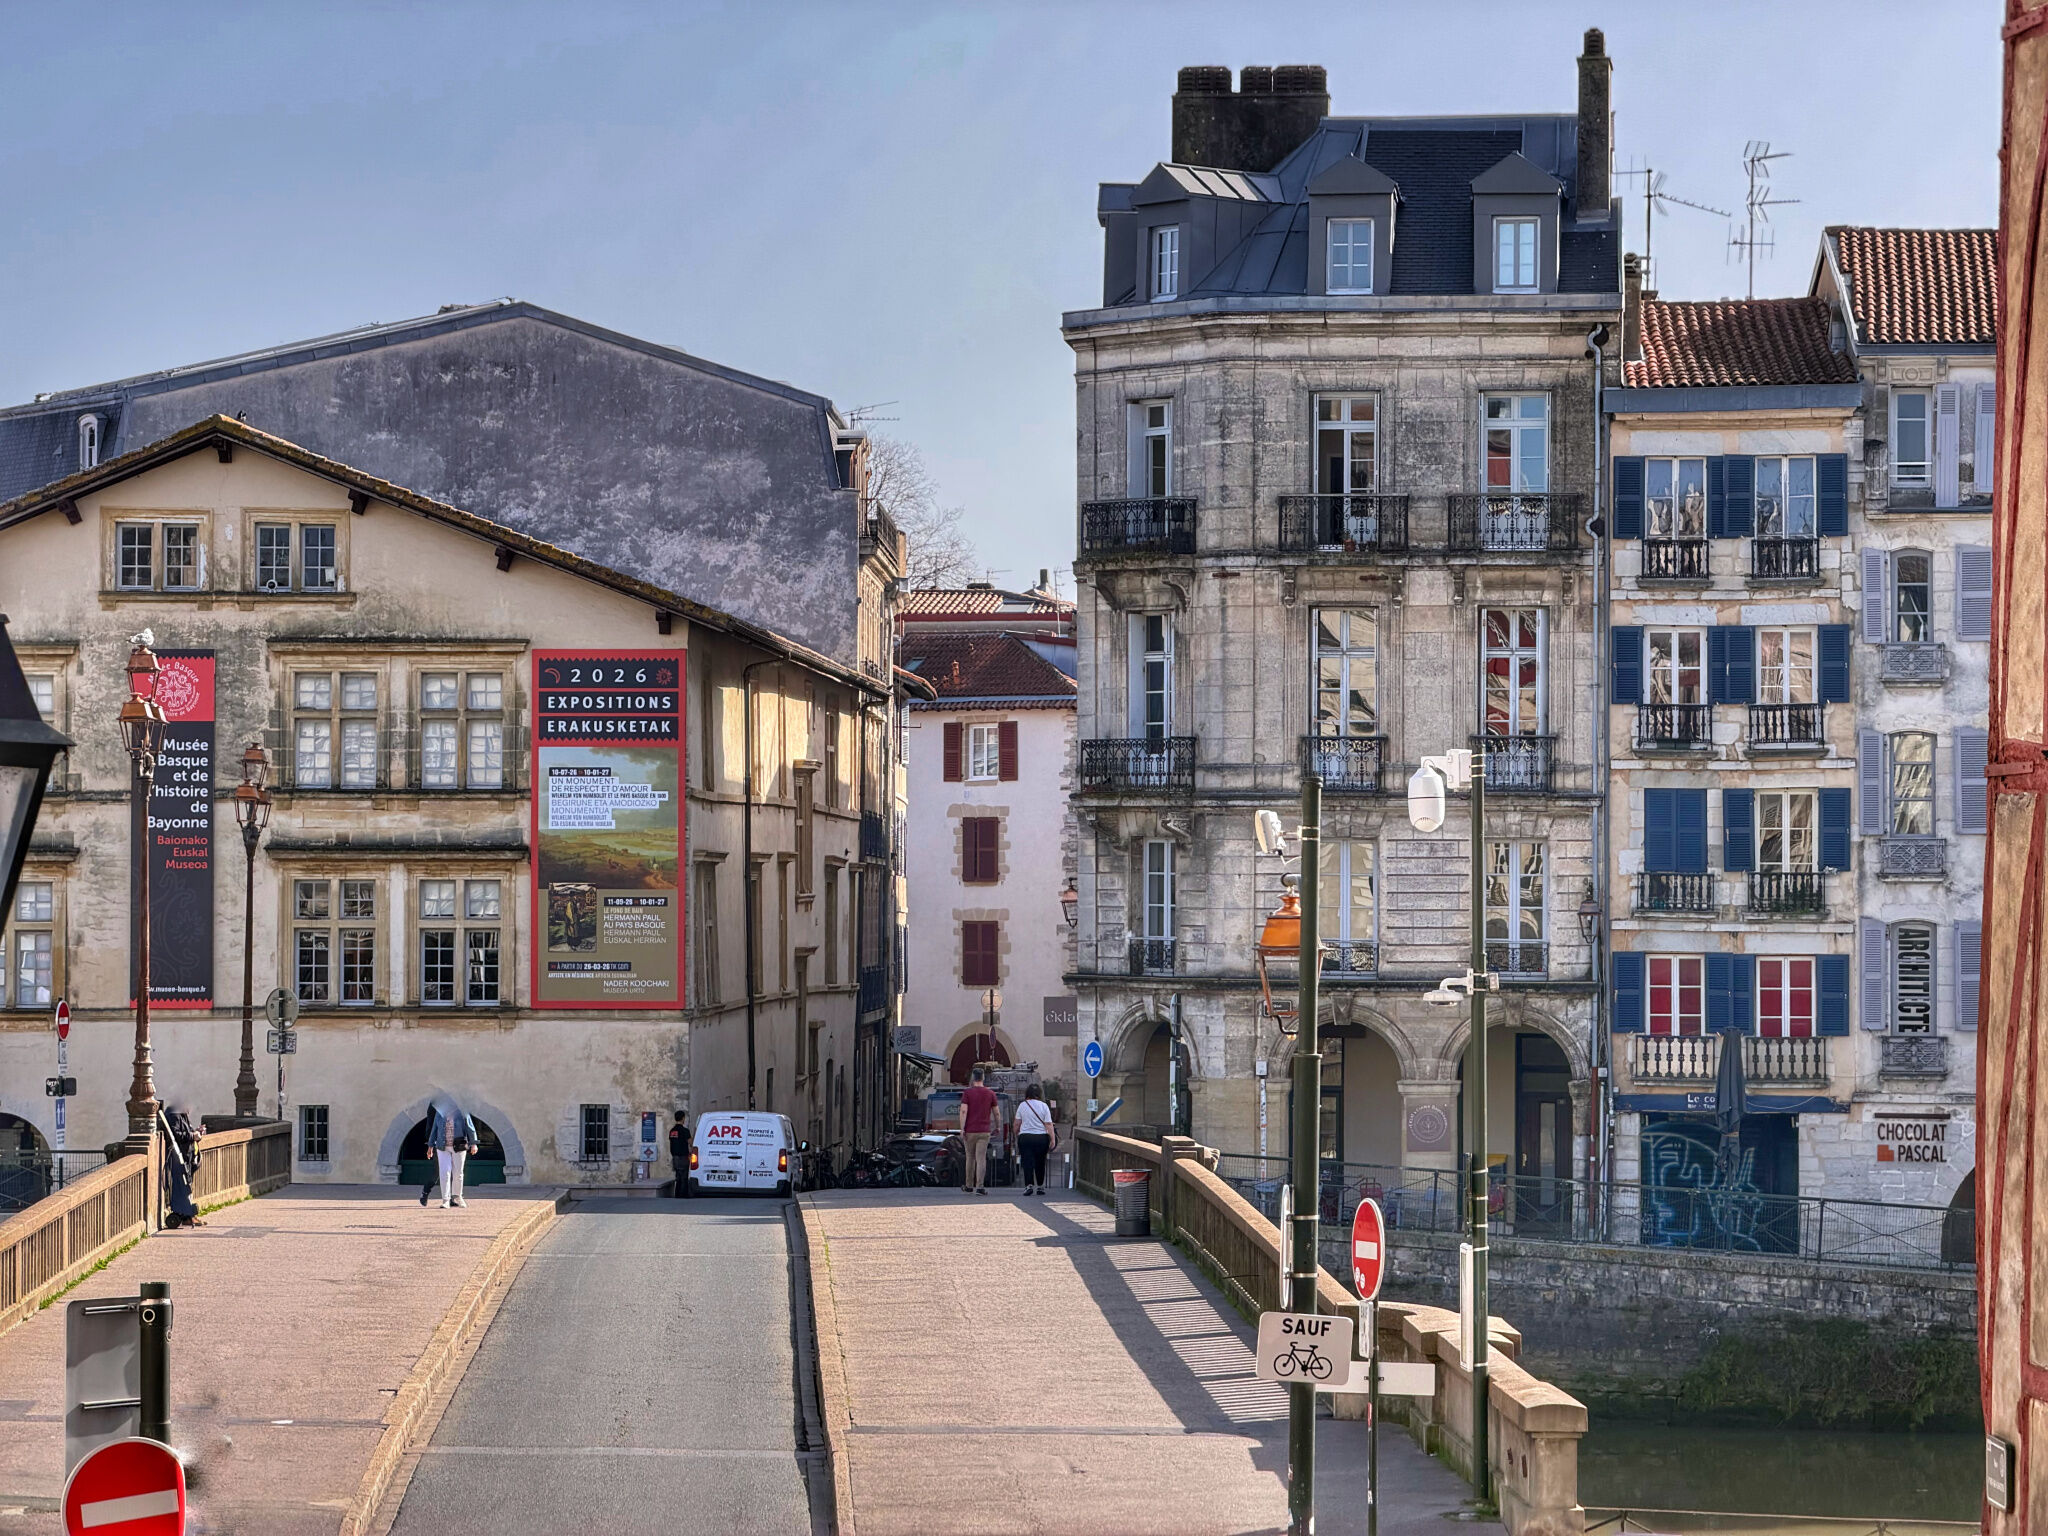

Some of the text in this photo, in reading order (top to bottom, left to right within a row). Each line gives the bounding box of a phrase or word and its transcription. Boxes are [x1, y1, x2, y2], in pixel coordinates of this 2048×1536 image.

[175, 662, 199, 682] Basque
[571, 669, 646, 683] 2026
[548, 696, 672, 709] EXPOSITIONS
[547, 721, 671, 733] ERAKUSKETAK
[164, 739, 209, 750] Musée
[158, 754, 209, 769] Basque
[173, 770, 209, 782] et de
[149, 785, 209, 797] 'histoire
[190, 801, 209, 813] de
[148, 816, 208, 831] Bayonne
[158, 836, 208, 845] Baionako
[173, 848, 208, 857] Euskal
[165, 860, 208, 869] Museoa
[1898, 928, 1930, 1032] ARCHITECTE
[1688, 1094, 1700, 1103] Le
[708, 1125, 742, 1138] APR
[1878, 1123, 1947, 1142] CHOCOLAT
[1898, 1145, 1947, 1163] PASCAL
[1282, 1318, 1331, 1336] SAUF
